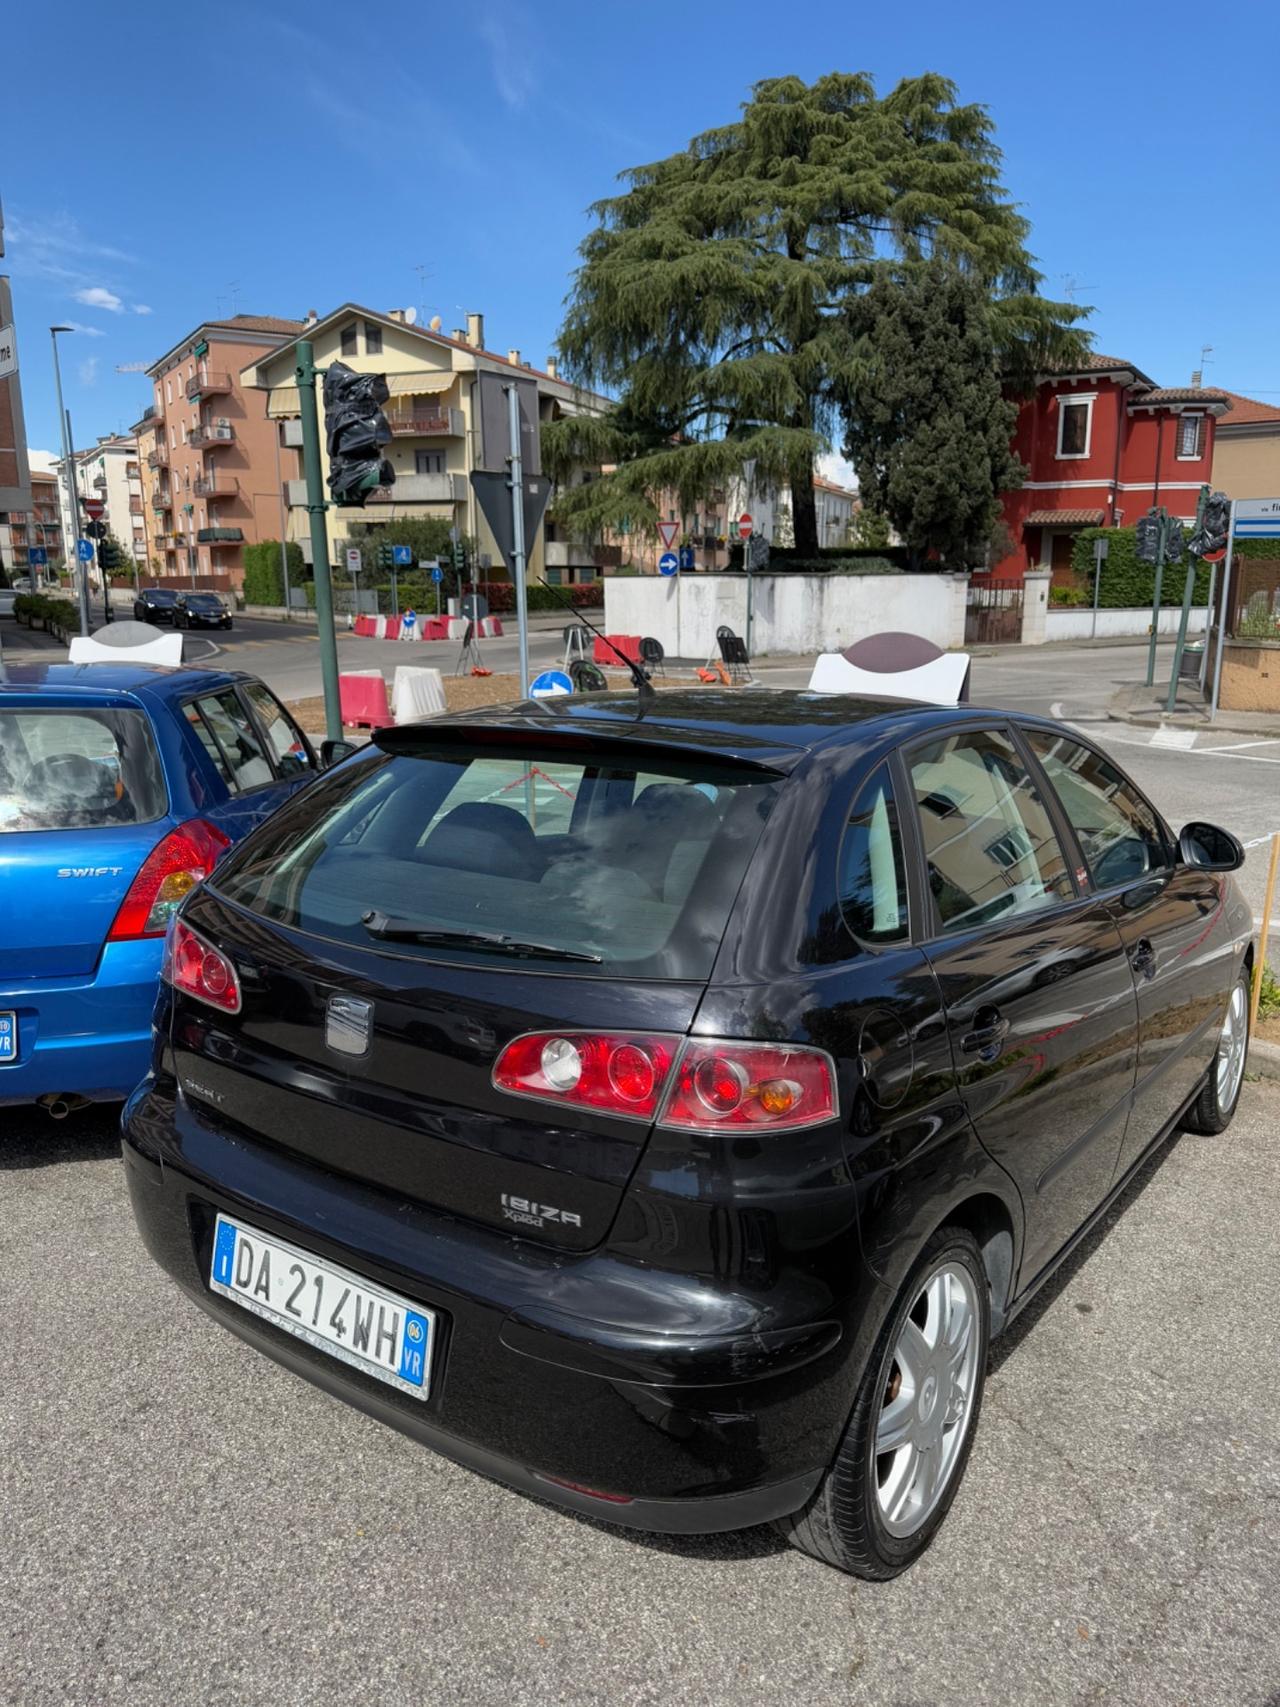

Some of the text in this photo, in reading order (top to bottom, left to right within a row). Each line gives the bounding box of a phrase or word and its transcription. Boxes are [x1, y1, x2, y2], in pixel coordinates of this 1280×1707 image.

[57, 866, 123, 879] SWIFT
[501, 1193, 582, 1228] IBIZA
[403, 1345, 421, 1377] VR
